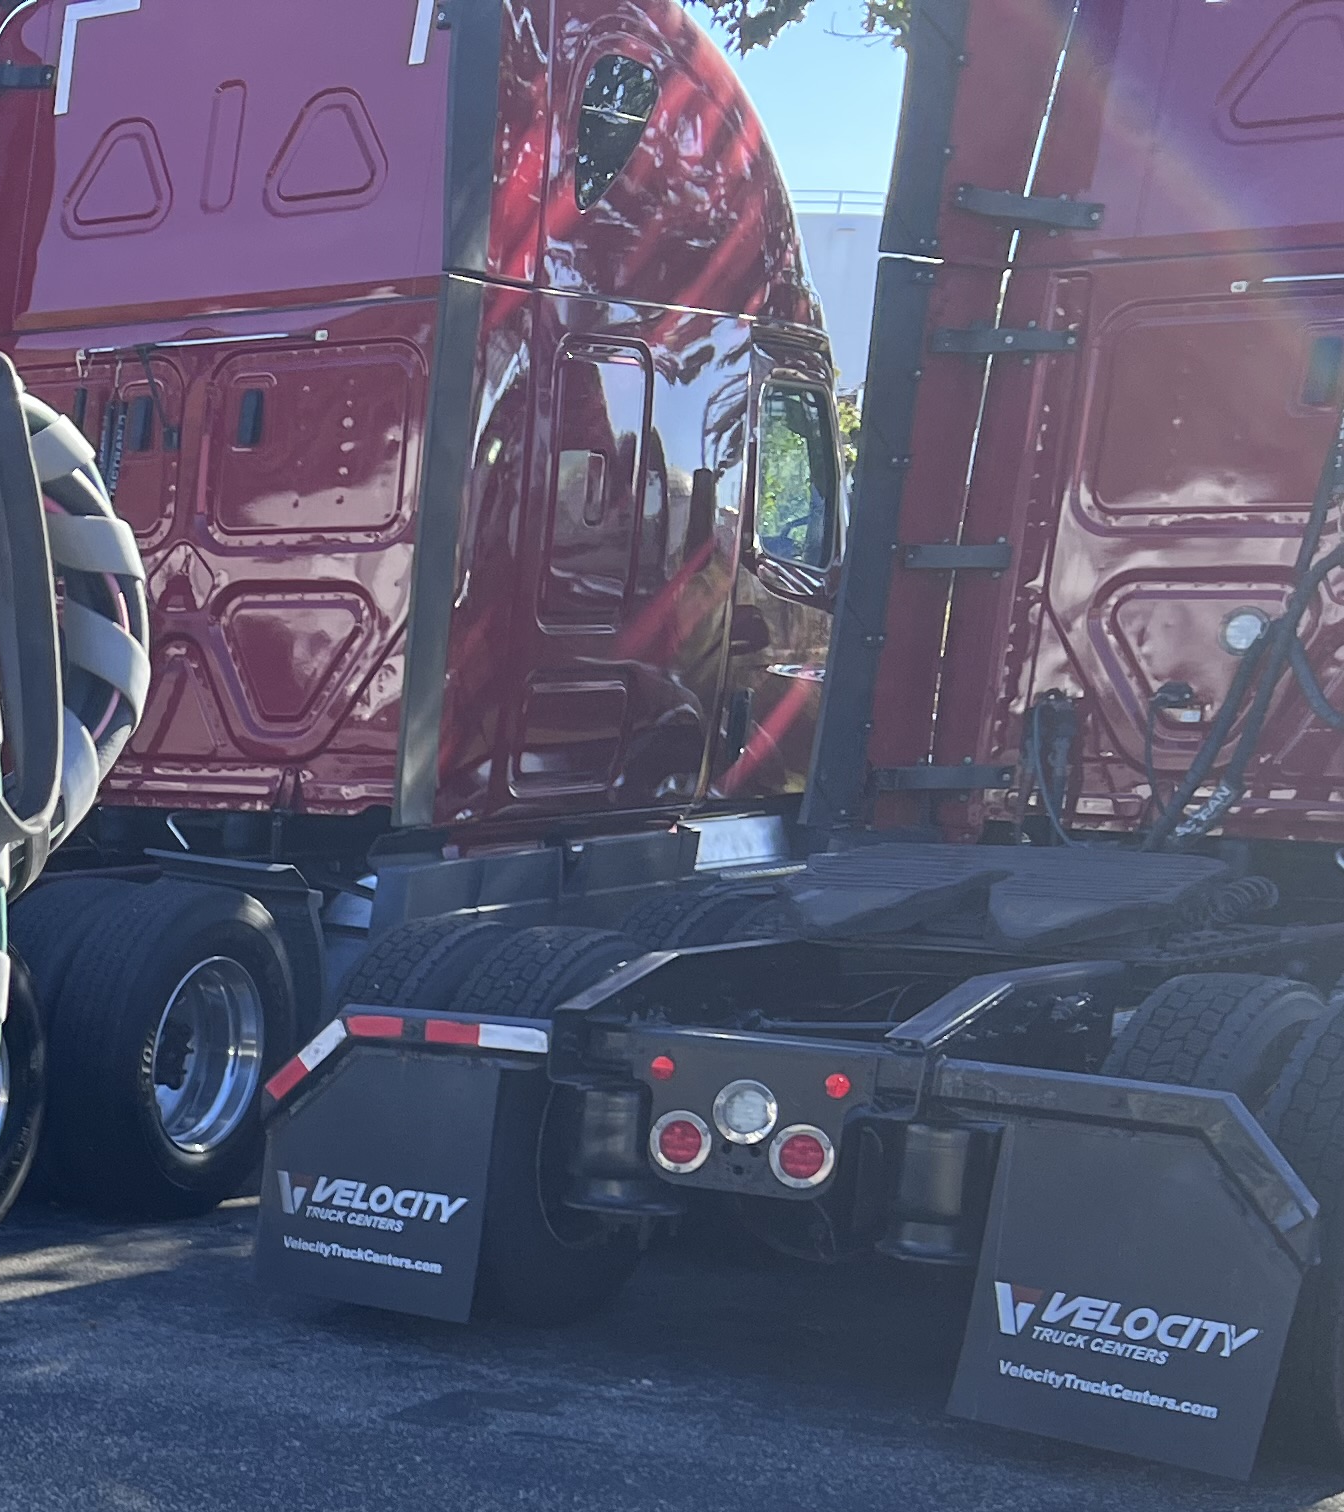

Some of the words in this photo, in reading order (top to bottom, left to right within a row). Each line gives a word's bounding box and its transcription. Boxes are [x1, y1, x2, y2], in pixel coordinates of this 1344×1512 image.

[305, 1205, 348, 1224] TRUCK
[346, 1211, 404, 1233] CENTERS
[311, 1175, 469, 1224] VELOCITY
[283, 1235, 443, 1275] VelocityTruckCenters.com
[1031, 1325, 1086, 1350] TRUCK
[1089, 1337, 1170, 1365] CENTERS
[1040, 1291, 1260, 1358] VELOCITY
[999, 1359, 1218, 1419] VelocityTruckCenters.com
